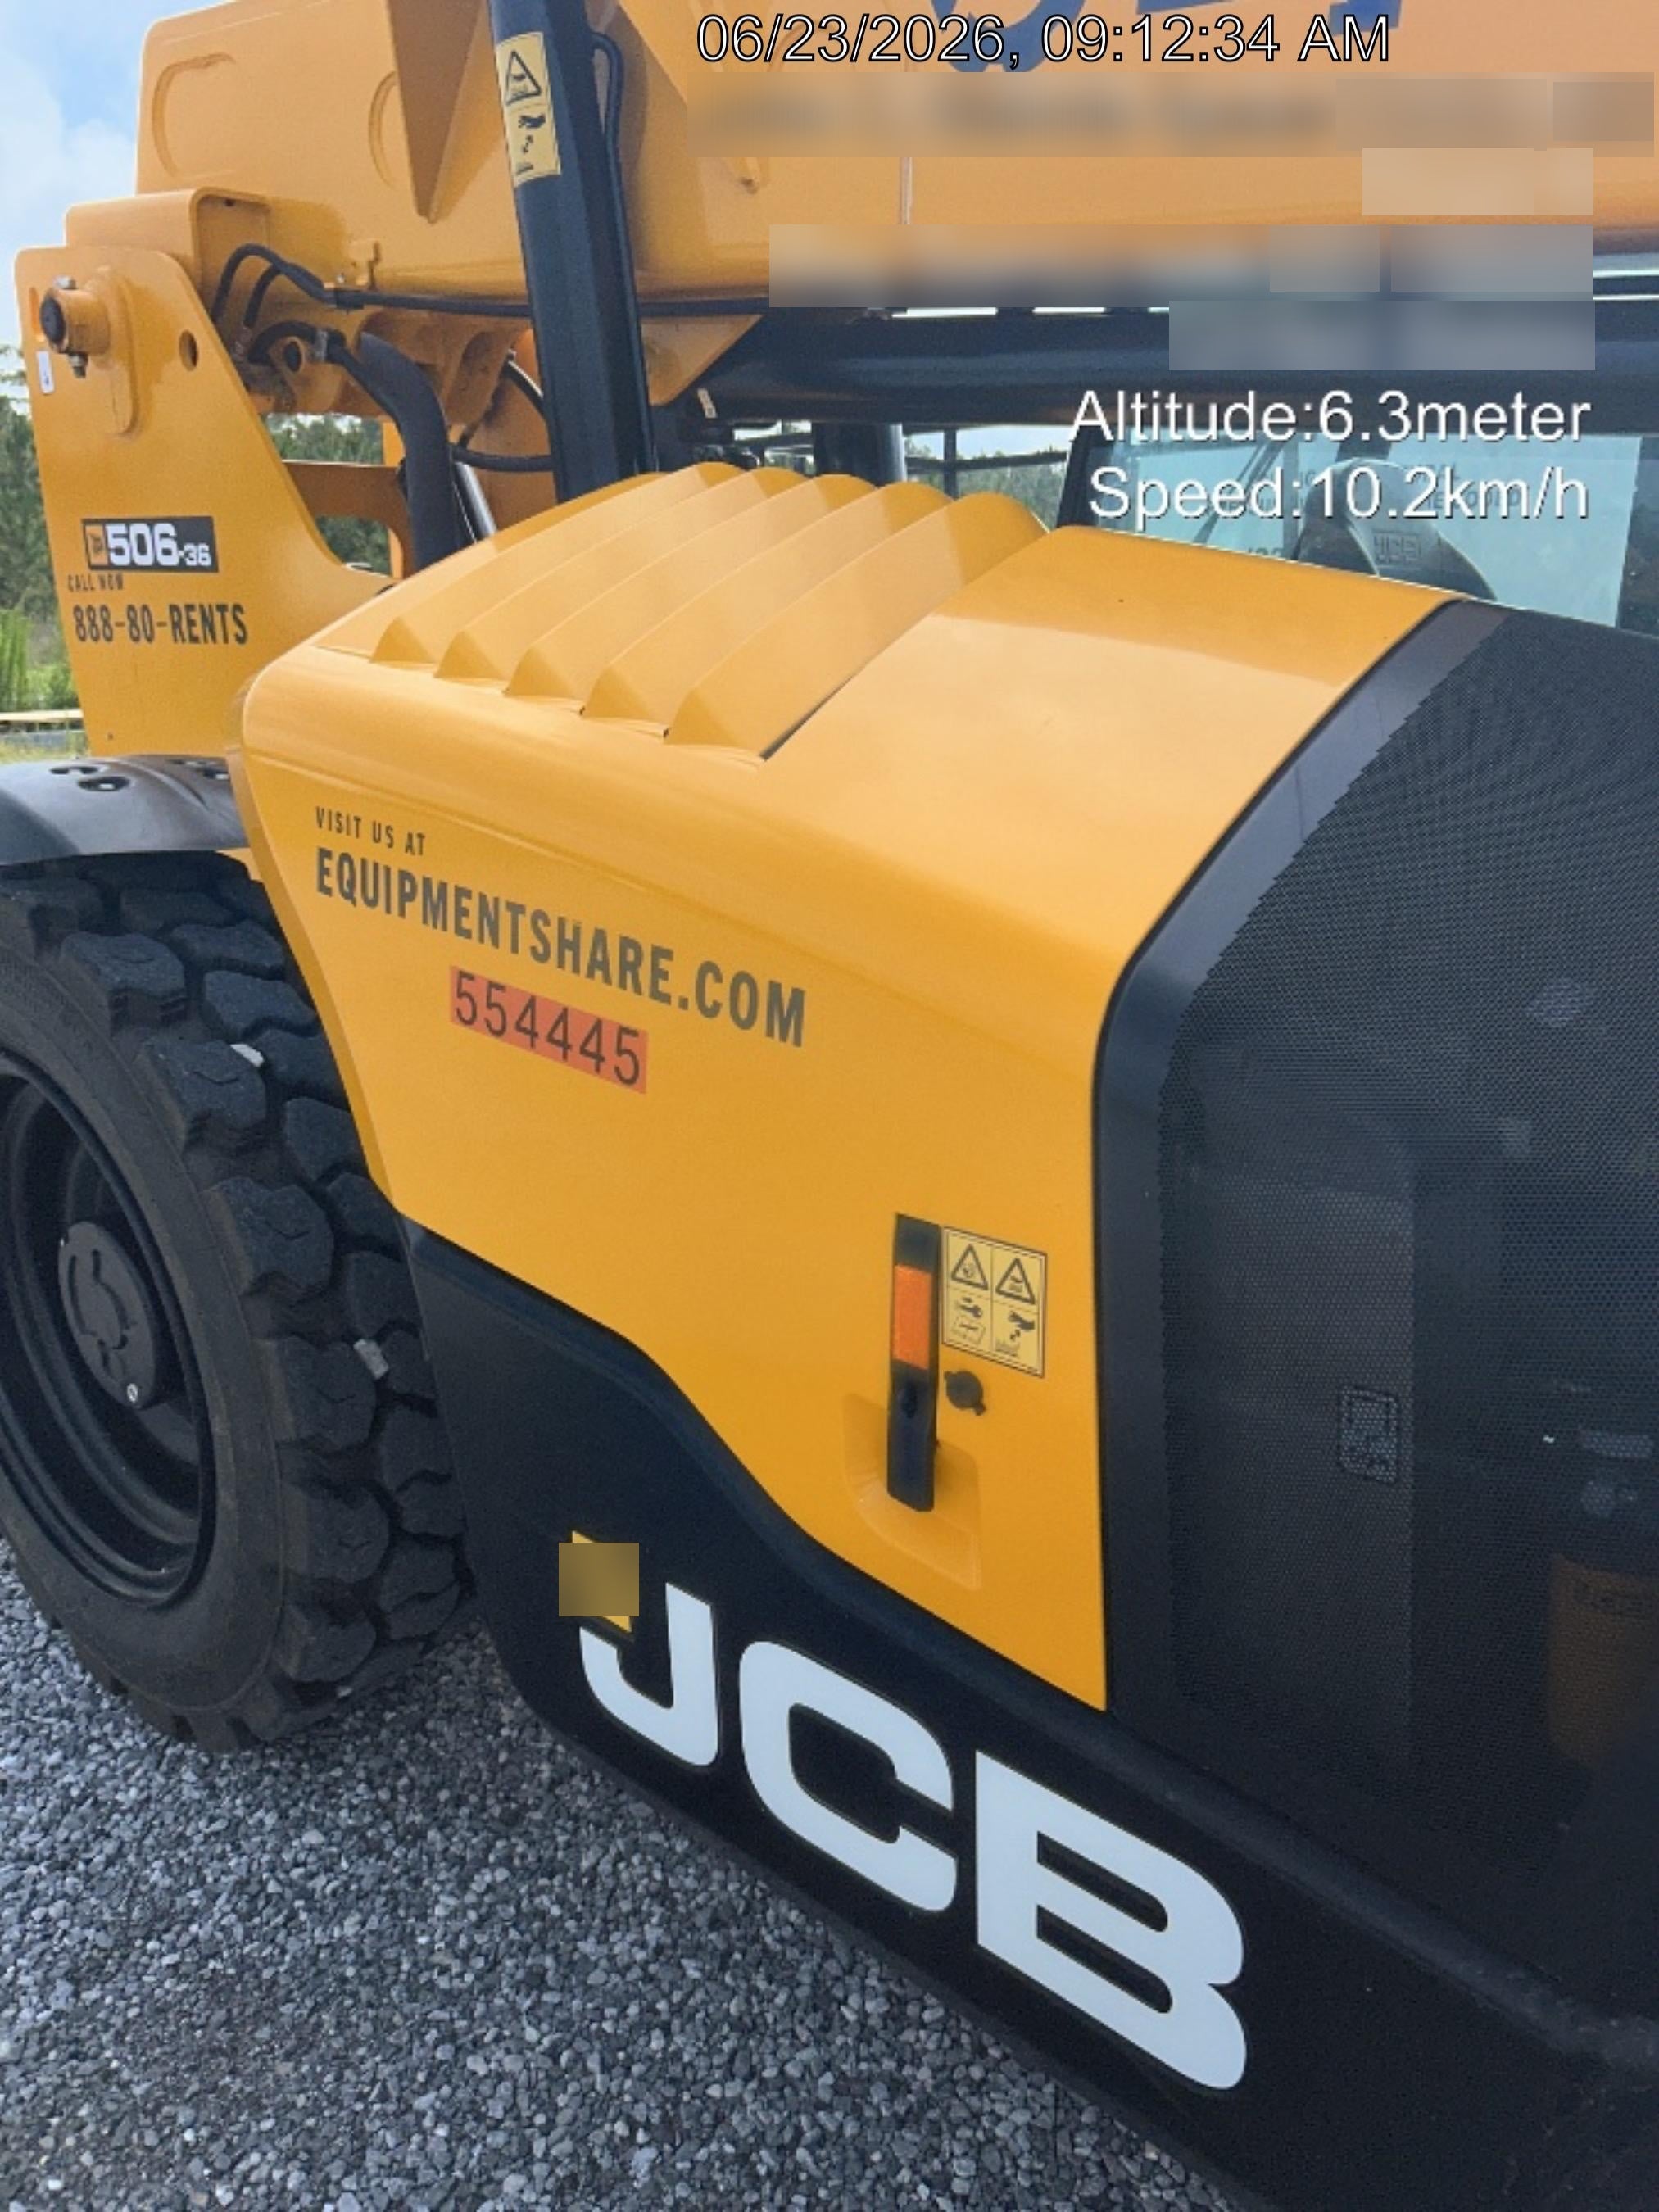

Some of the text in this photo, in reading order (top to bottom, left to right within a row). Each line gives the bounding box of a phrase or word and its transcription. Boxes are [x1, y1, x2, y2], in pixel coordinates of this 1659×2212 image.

[67, 573, 124, 592] CALL NOW
[73, 603, 249, 645] 888-80-RENTS
[315, 805, 426, 856] VISIT US AT
[316, 845, 806, 1048] EQUIPMENTSHARE.COM
[455, 969, 641, 1087] 554445
[578, 1581, 1249, 2091] JCB
